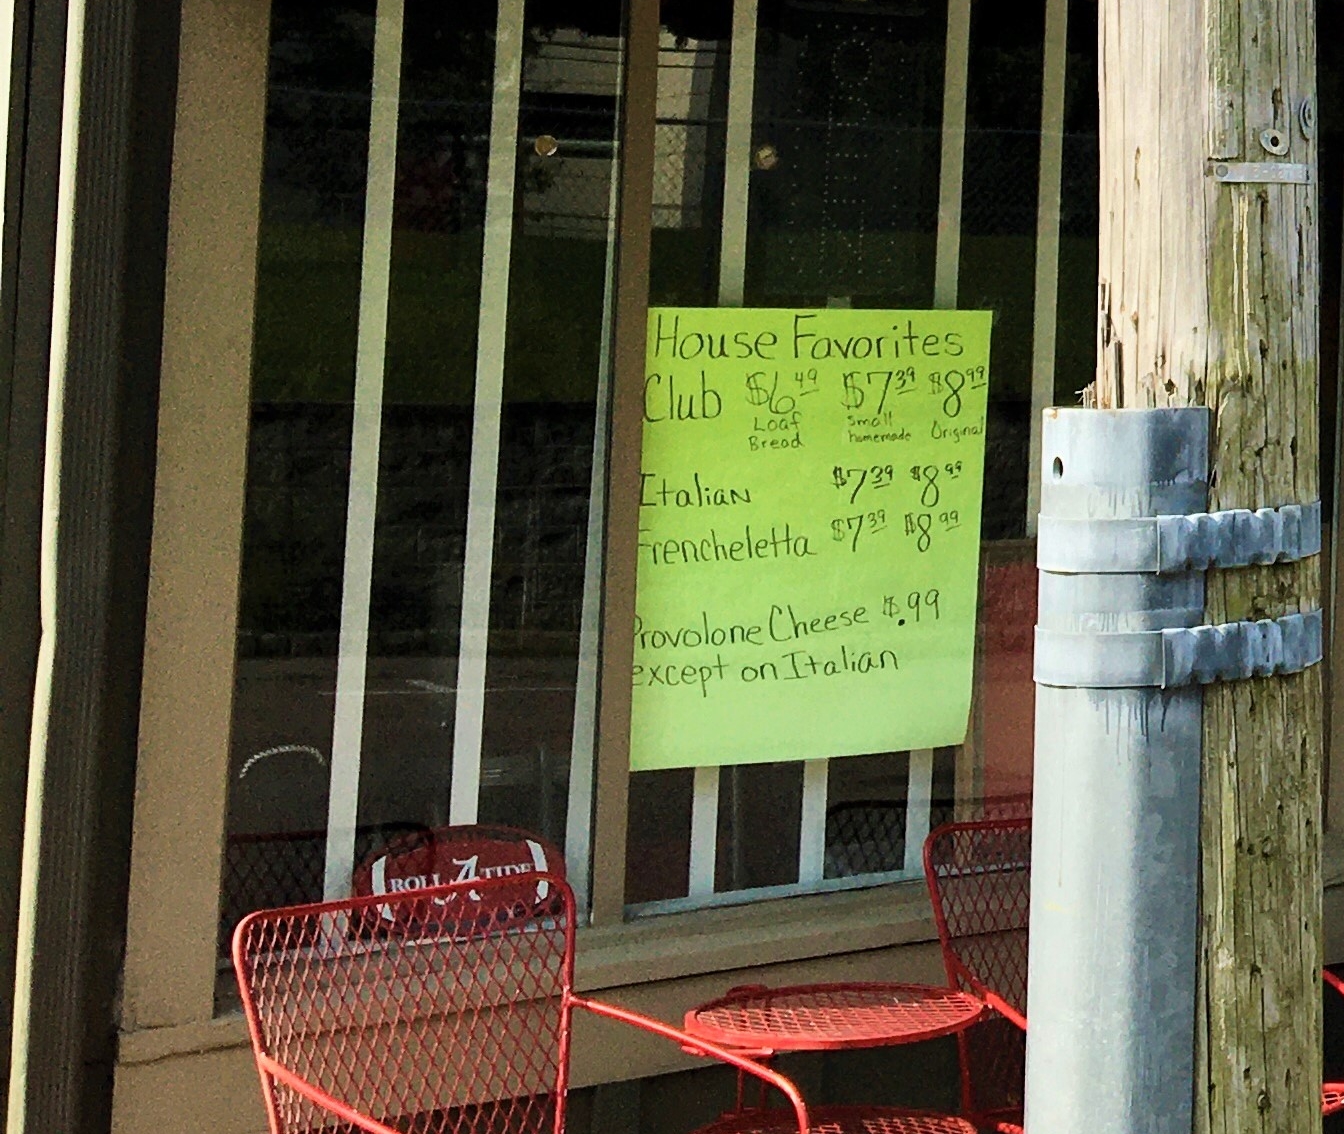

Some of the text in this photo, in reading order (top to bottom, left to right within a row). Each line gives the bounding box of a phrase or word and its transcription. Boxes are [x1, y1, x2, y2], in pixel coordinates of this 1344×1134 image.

[654, 314, 964, 360] House Favorites
[643, 370, 722, 423] Club
[748, 432, 804, 452] Bread
[754, 411, 802, 432] Loaf
[769, 604, 870, 642] Cheese
[631, 645, 900, 698] except on Italian
